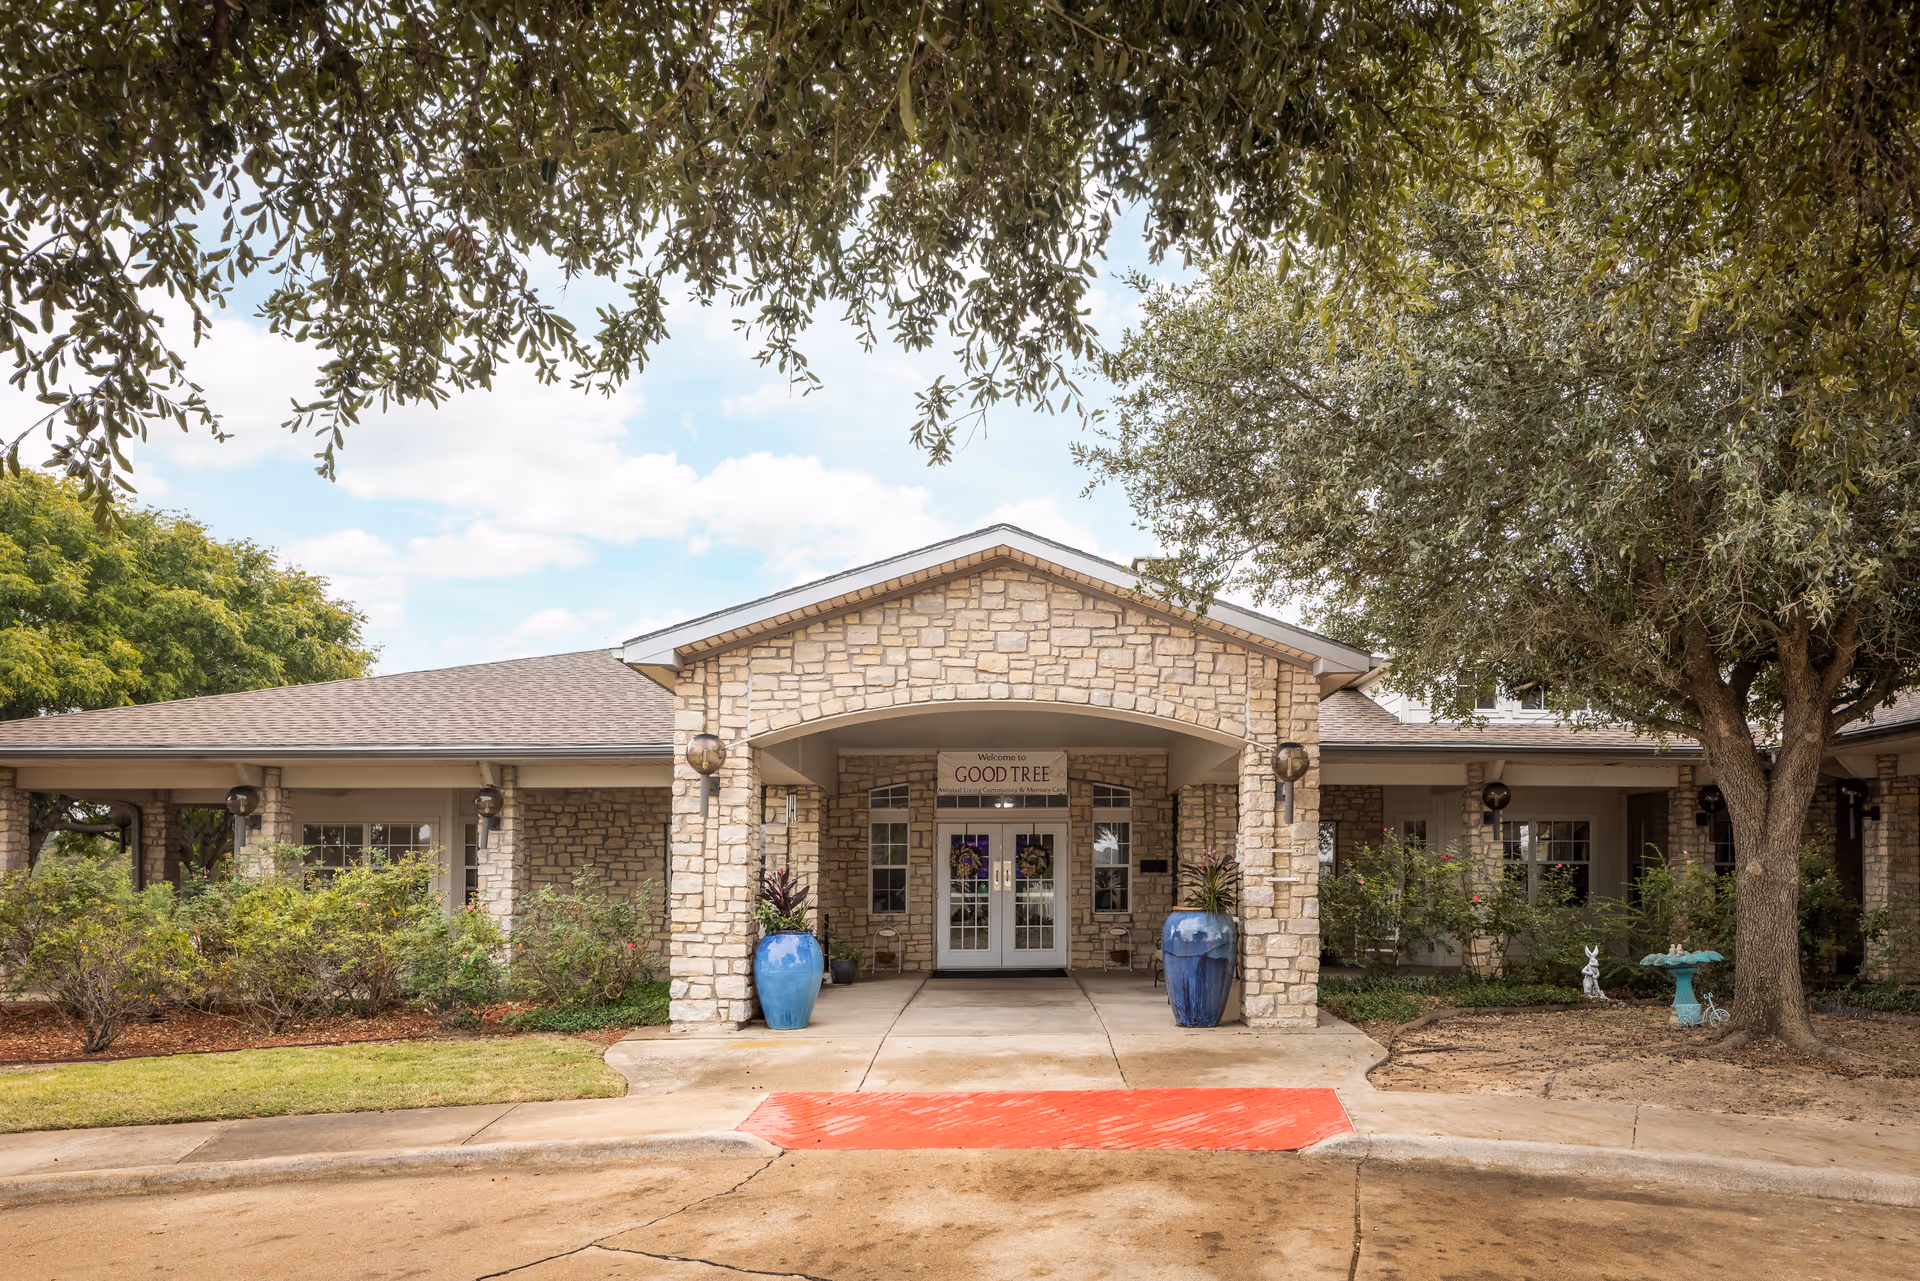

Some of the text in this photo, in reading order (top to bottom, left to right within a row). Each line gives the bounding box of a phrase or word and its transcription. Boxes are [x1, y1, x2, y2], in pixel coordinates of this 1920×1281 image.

[978, 753, 1016, 761] Welcome
[955, 766, 1050, 783] GOOD TREE
